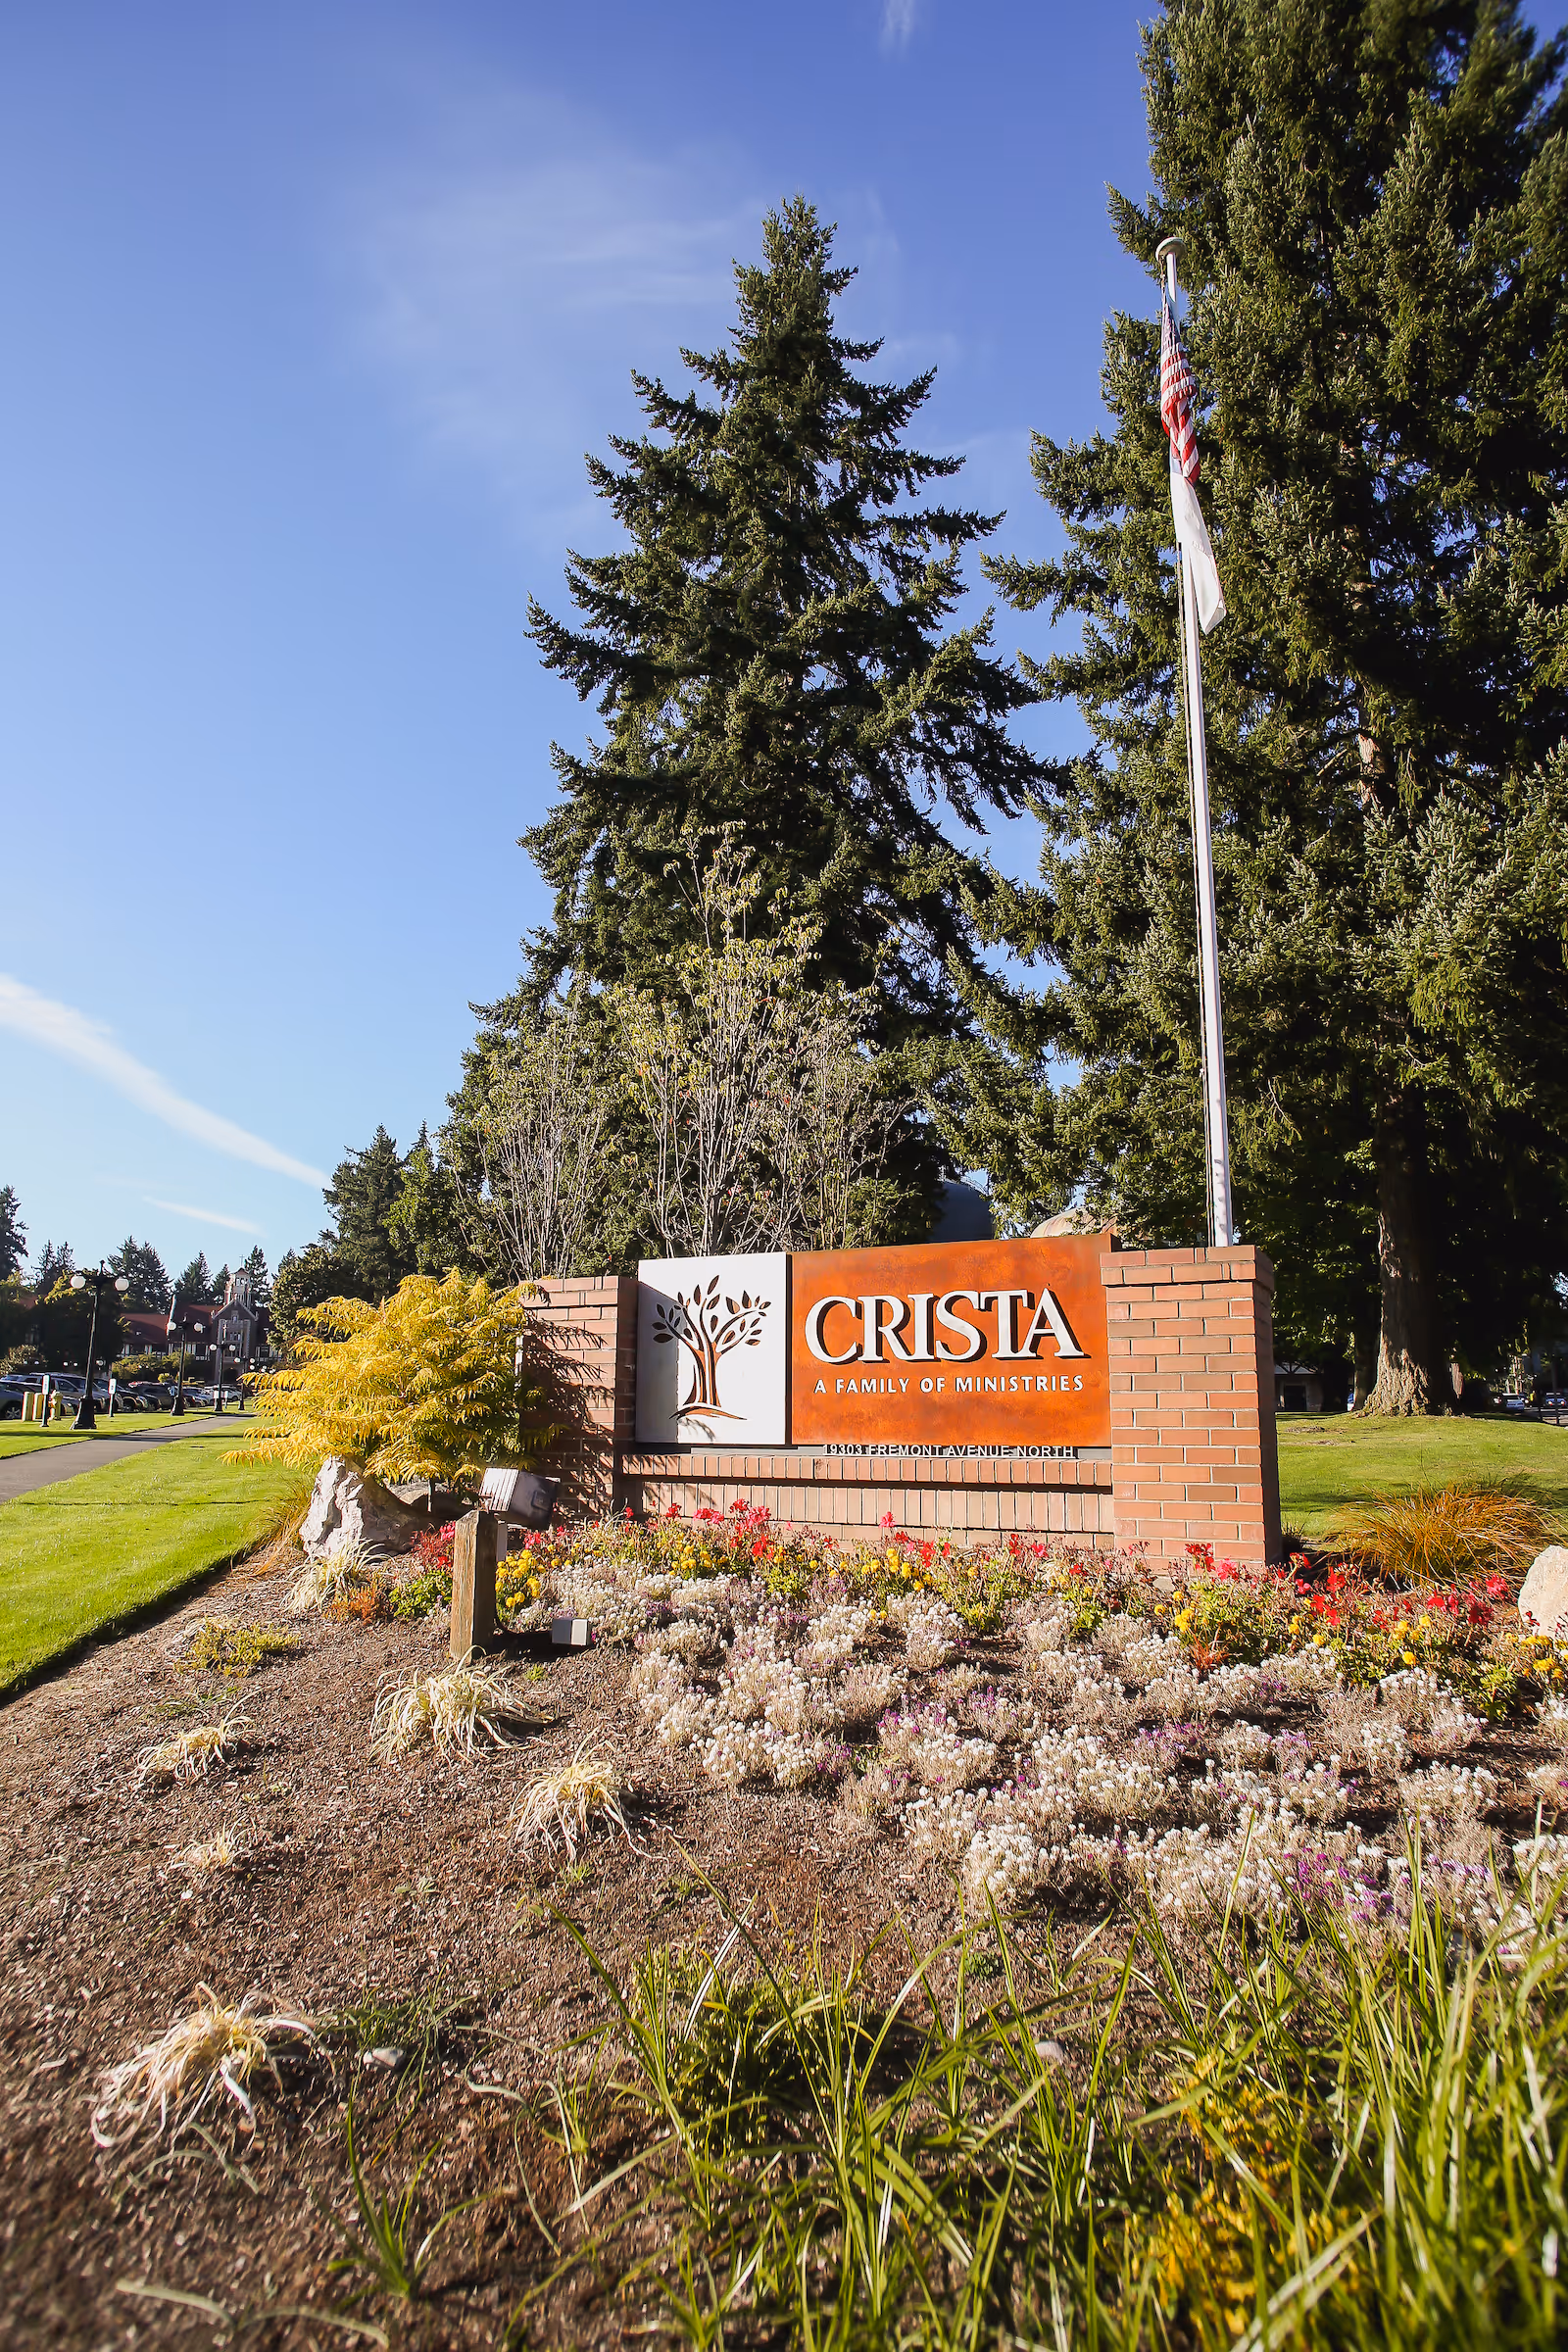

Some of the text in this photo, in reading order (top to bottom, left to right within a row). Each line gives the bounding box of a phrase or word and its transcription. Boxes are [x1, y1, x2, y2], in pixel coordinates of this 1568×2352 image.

[804, 1287, 1086, 1364] CRISTA
[814, 1374, 1085, 1394] A FAMILY OF MINISTRIES
[823, 1444, 1074, 1458] 19303 FREMONT AVENUE NORTH
